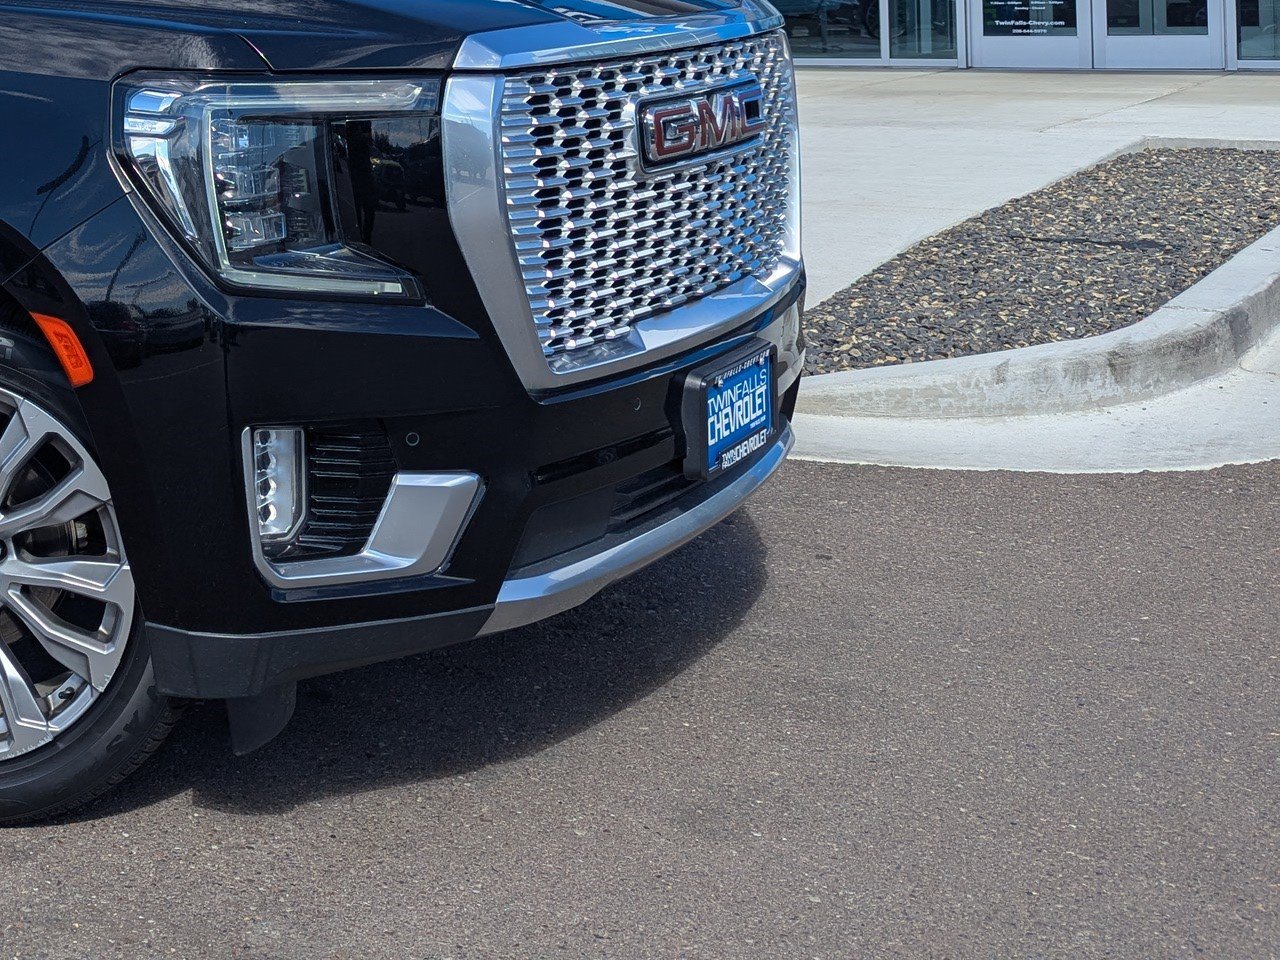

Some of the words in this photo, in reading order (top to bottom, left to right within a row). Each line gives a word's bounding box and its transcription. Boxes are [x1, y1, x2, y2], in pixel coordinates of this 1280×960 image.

[650, 86, 767, 158] GMC
[708, 385, 767, 446] CHEVROLET
[735, 428, 767, 461] CHEVROLET
